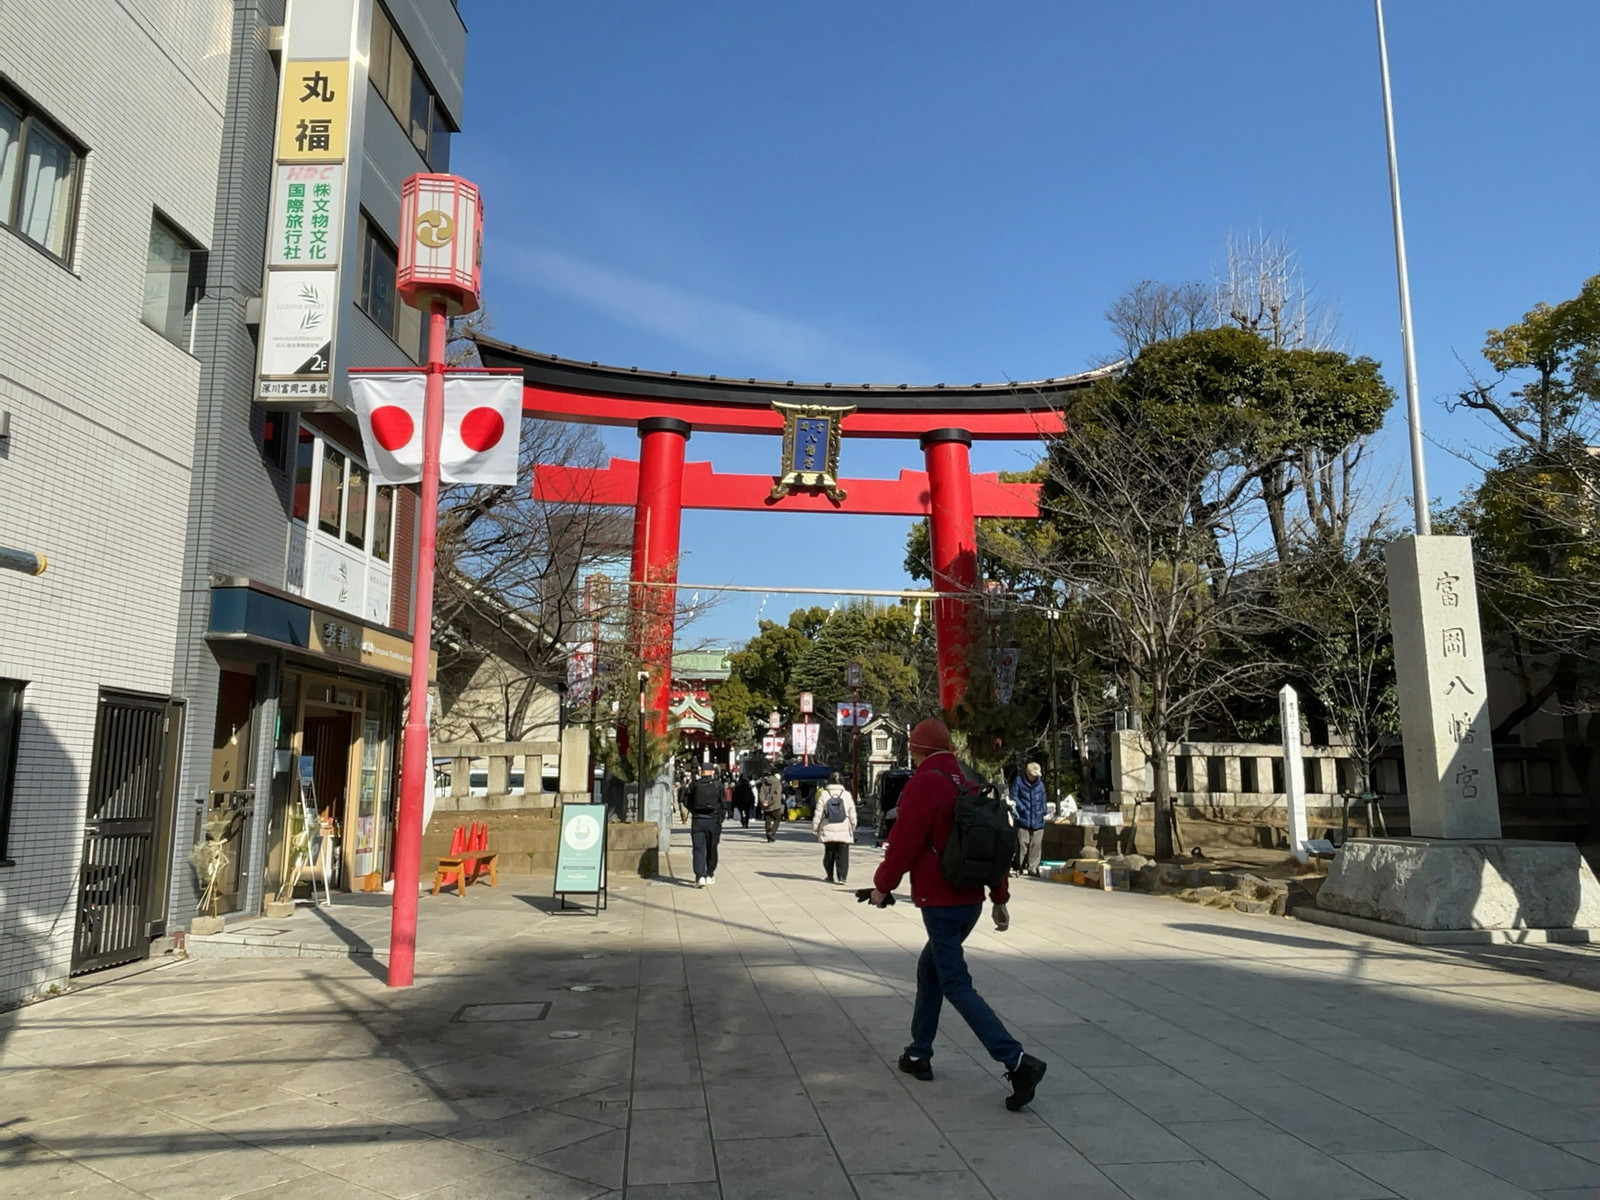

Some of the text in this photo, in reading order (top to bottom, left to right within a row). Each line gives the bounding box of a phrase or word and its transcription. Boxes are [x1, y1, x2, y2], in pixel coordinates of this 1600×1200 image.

[295, 70, 335, 152] 丸福
[283, 183, 305, 260] 国際旅行社
[262, 383, 328, 394] 深川富岡二番館
[310, 354, 328, 371] 2F
[1436, 571, 1479, 799] 富岡八幡宮
